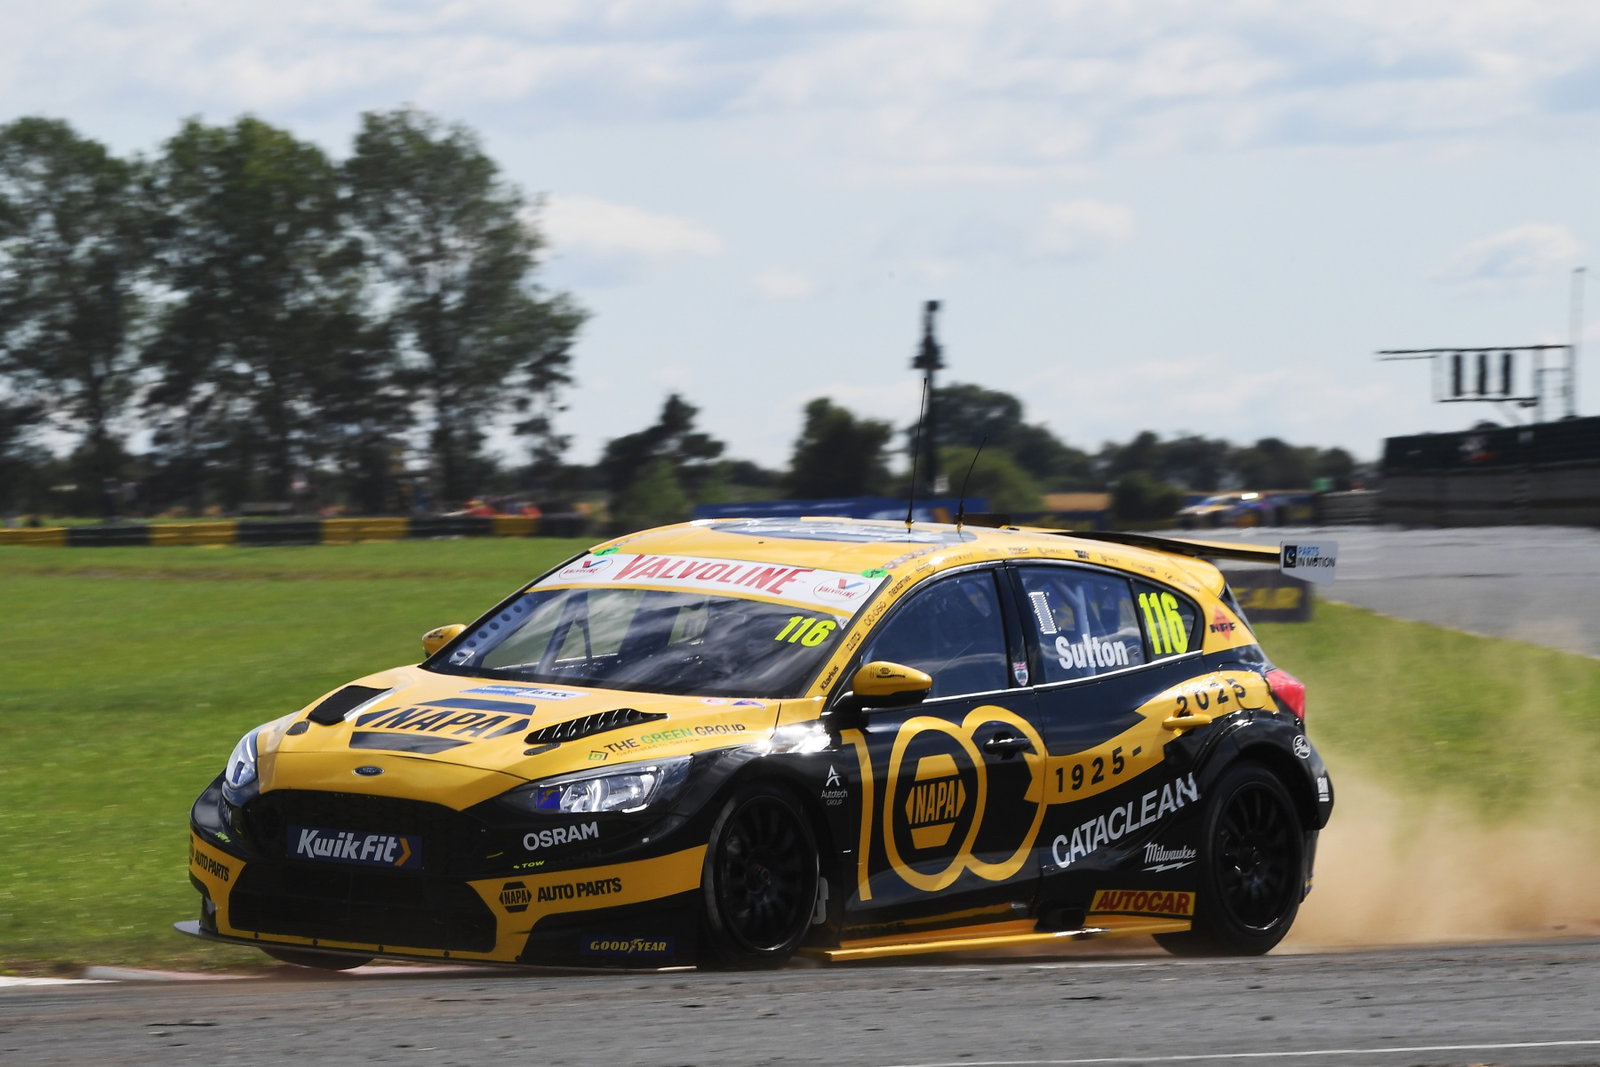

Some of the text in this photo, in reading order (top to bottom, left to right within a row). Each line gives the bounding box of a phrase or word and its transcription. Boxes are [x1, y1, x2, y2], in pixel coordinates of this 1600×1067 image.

[612, 554, 816, 595] VALVOLINE
[774, 615, 838, 647] 116
[1138, 591, 1188, 656] 116
[1056, 635, 1128, 671] Sutton
[1176, 678, 1247, 717] 2025
[371, 707, 511, 738] NAPA
[603, 737, 640, 754] THE
[640, 727, 694, 745] GREEN
[694, 724, 746, 736] GROUP
[821, 789, 848, 799] Autotech
[914, 780, 955, 824] NAPA
[1051, 772, 1202, 869] CATACLEAN
[523, 821, 600, 852] OSRAM
[1143, 841, 1197, 862] Milwaukee
[194, 849, 230, 882] AUTO PARTS
[521, 860, 545, 869] TOW
[504, 876, 622, 905] NAPA AUTO PARTS
[1093, 890, 1192, 915] AUTOCAR
[590, 938, 667, 954] GOODYEAR
